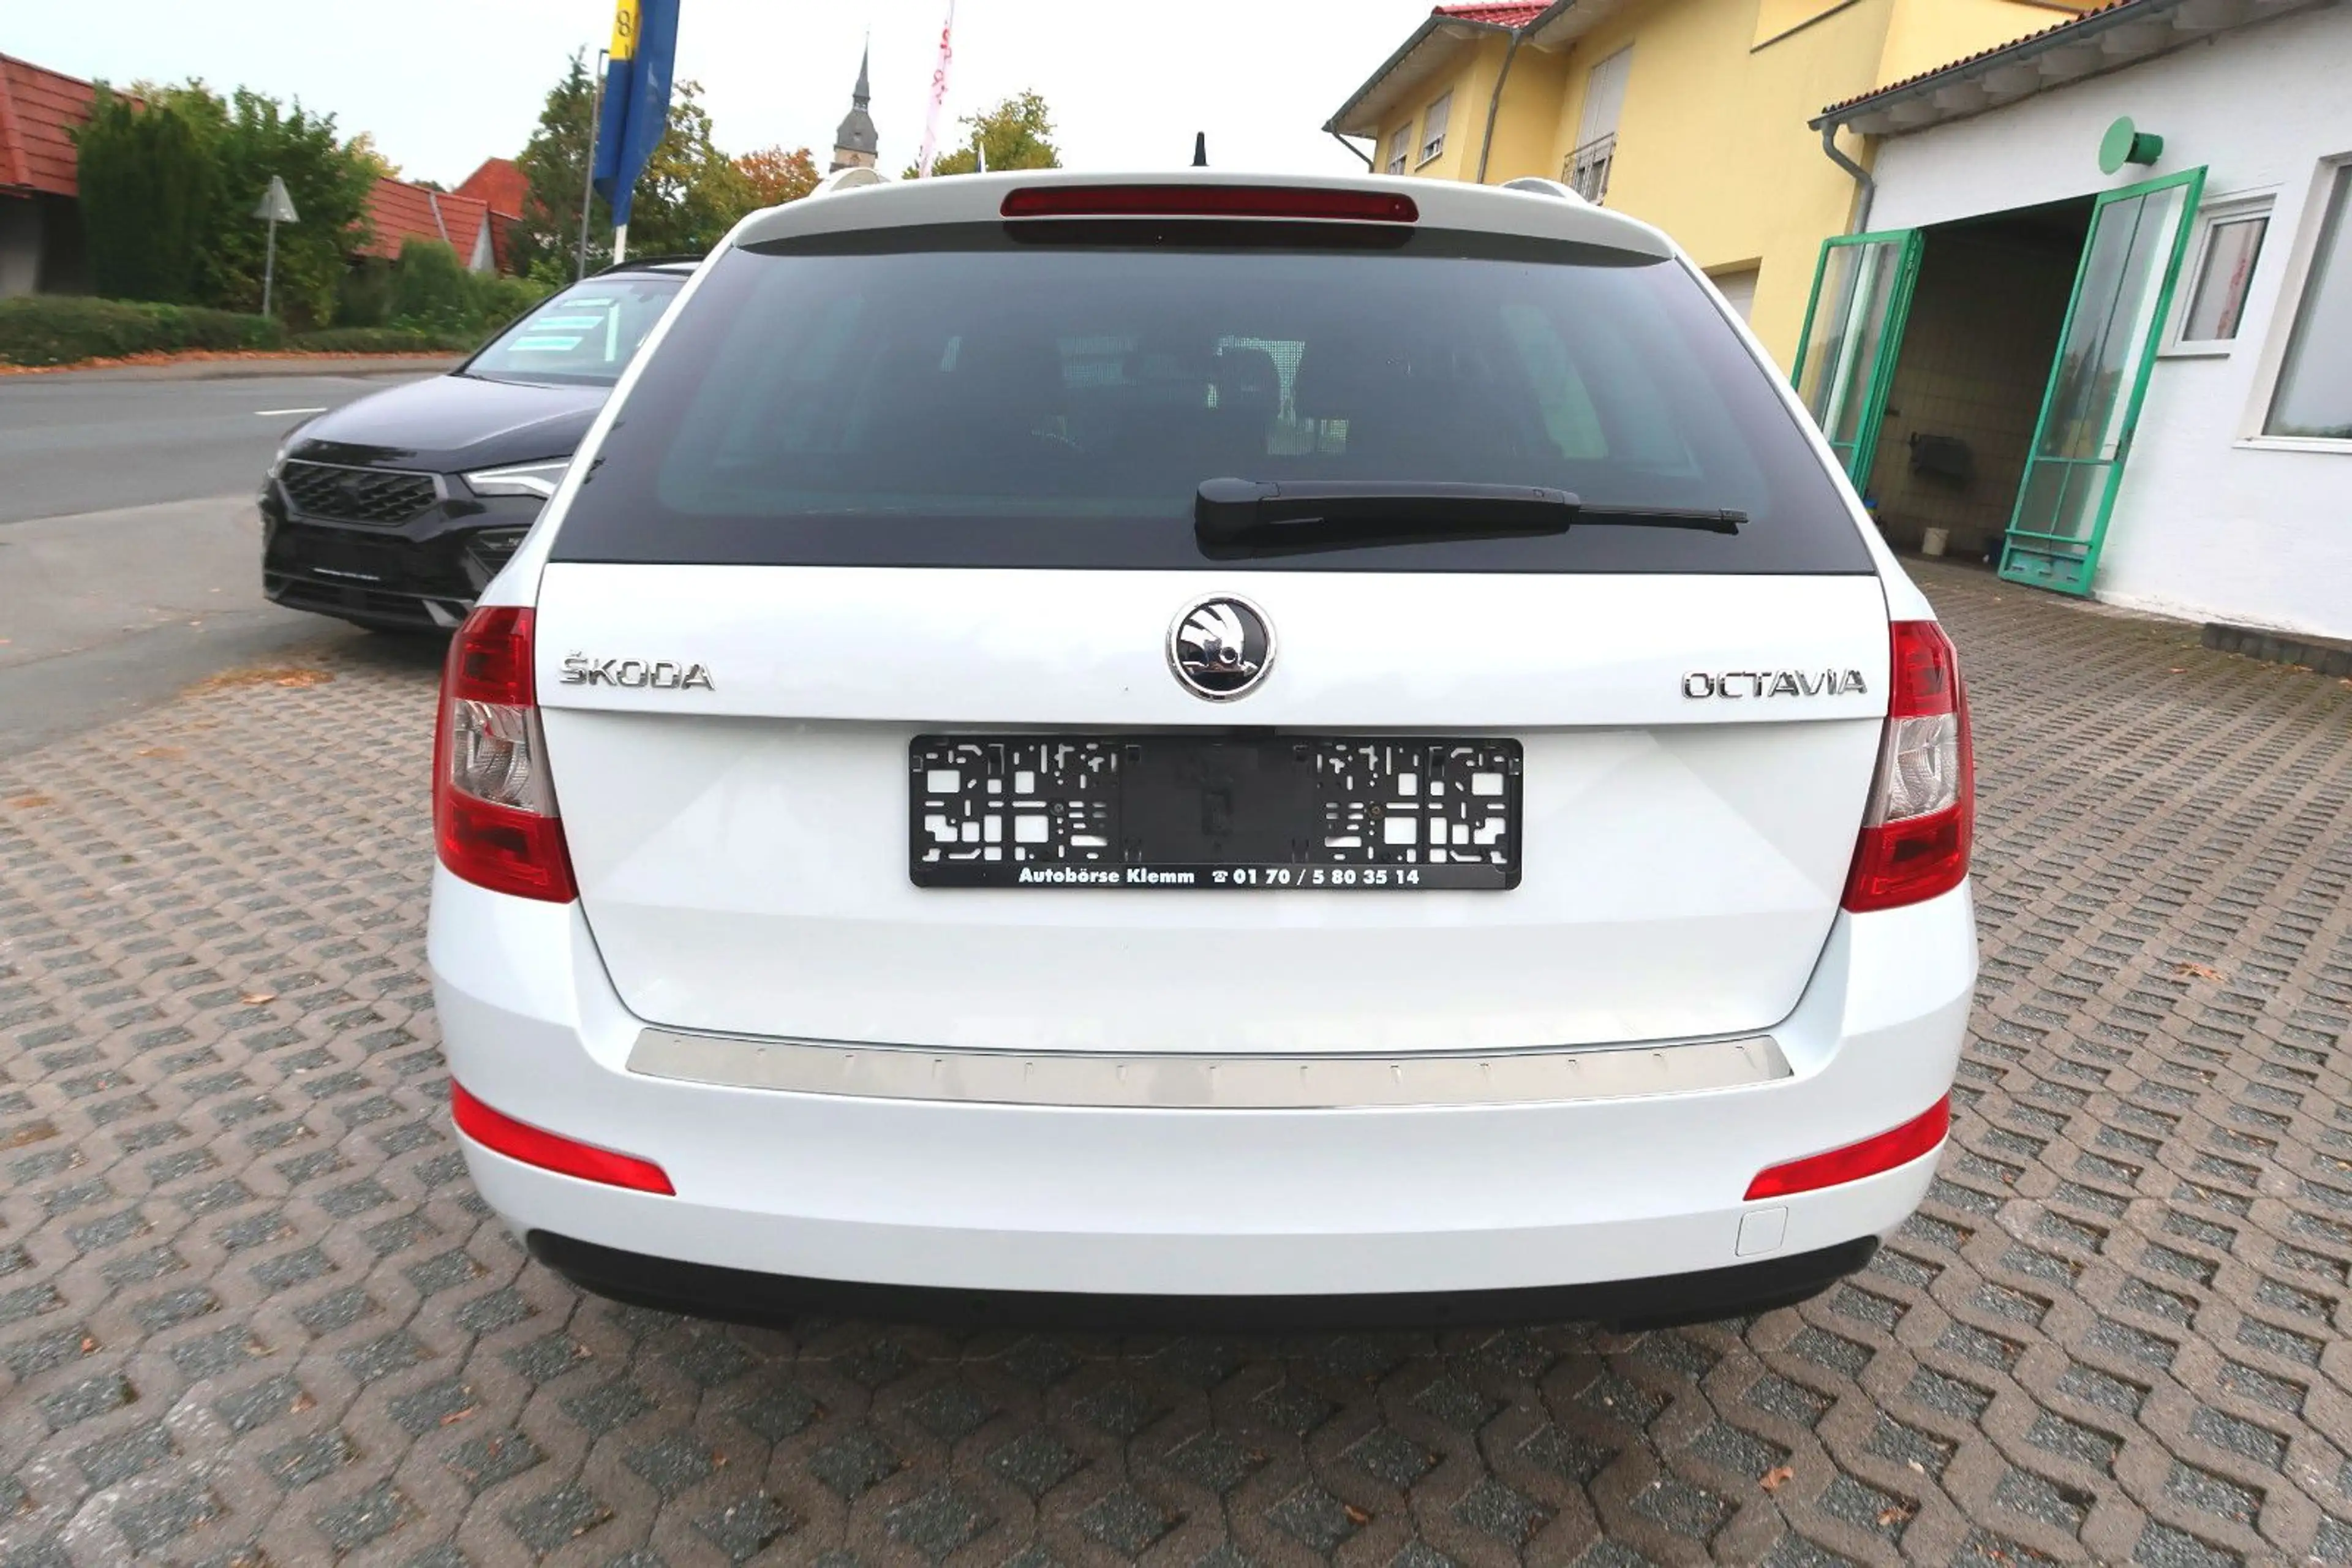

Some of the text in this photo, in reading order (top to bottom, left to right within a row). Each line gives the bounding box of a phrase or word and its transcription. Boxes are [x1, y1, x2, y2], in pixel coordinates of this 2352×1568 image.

[559, 649, 716, 692] ŠKODA
[1681, 668, 1868, 699] OCTAVIA
[1018, 867, 1120, 884] Autobörse
[1126, 867, 1196, 884] Klemm
[1232, 868, 1257, 884] 01
[1265, 868, 1291, 884] 70
[1331, 868, 1357, 884] 80
[1362, 869, 1388, 885] 35
[1396, 869, 1420, 885] 14
